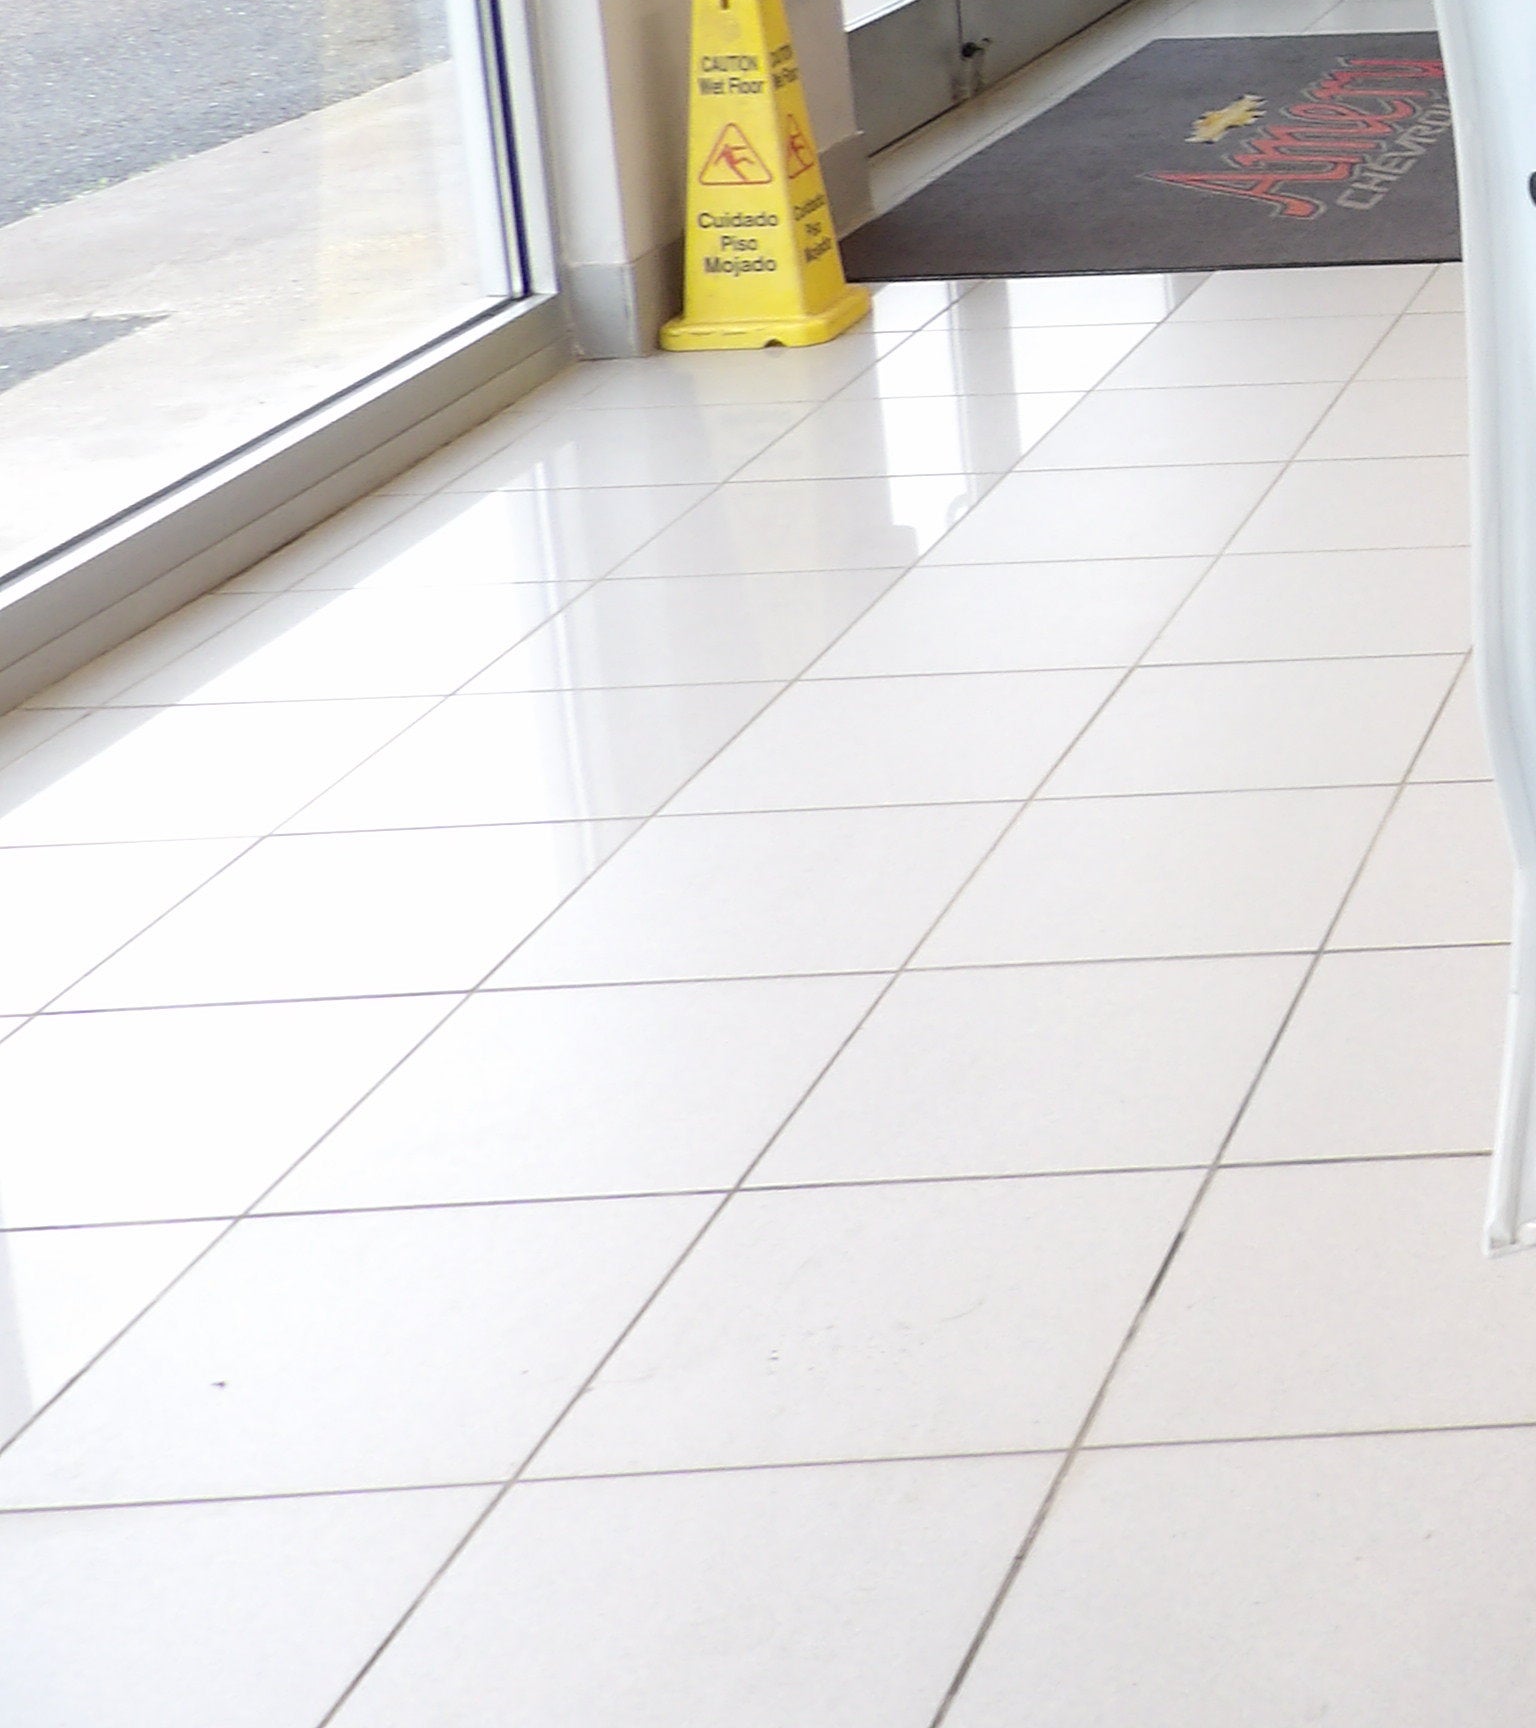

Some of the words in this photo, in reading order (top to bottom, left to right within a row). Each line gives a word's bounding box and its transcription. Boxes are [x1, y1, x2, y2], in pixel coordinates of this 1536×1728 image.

[702, 55, 759, 72] CAUTION
[698, 77, 725, 95] Wet
[729, 76, 765, 95] Floor
[698, 211, 778, 228] Cuidado
[721, 234, 758, 251] Piso
[704, 255, 777, 277] Mojado
